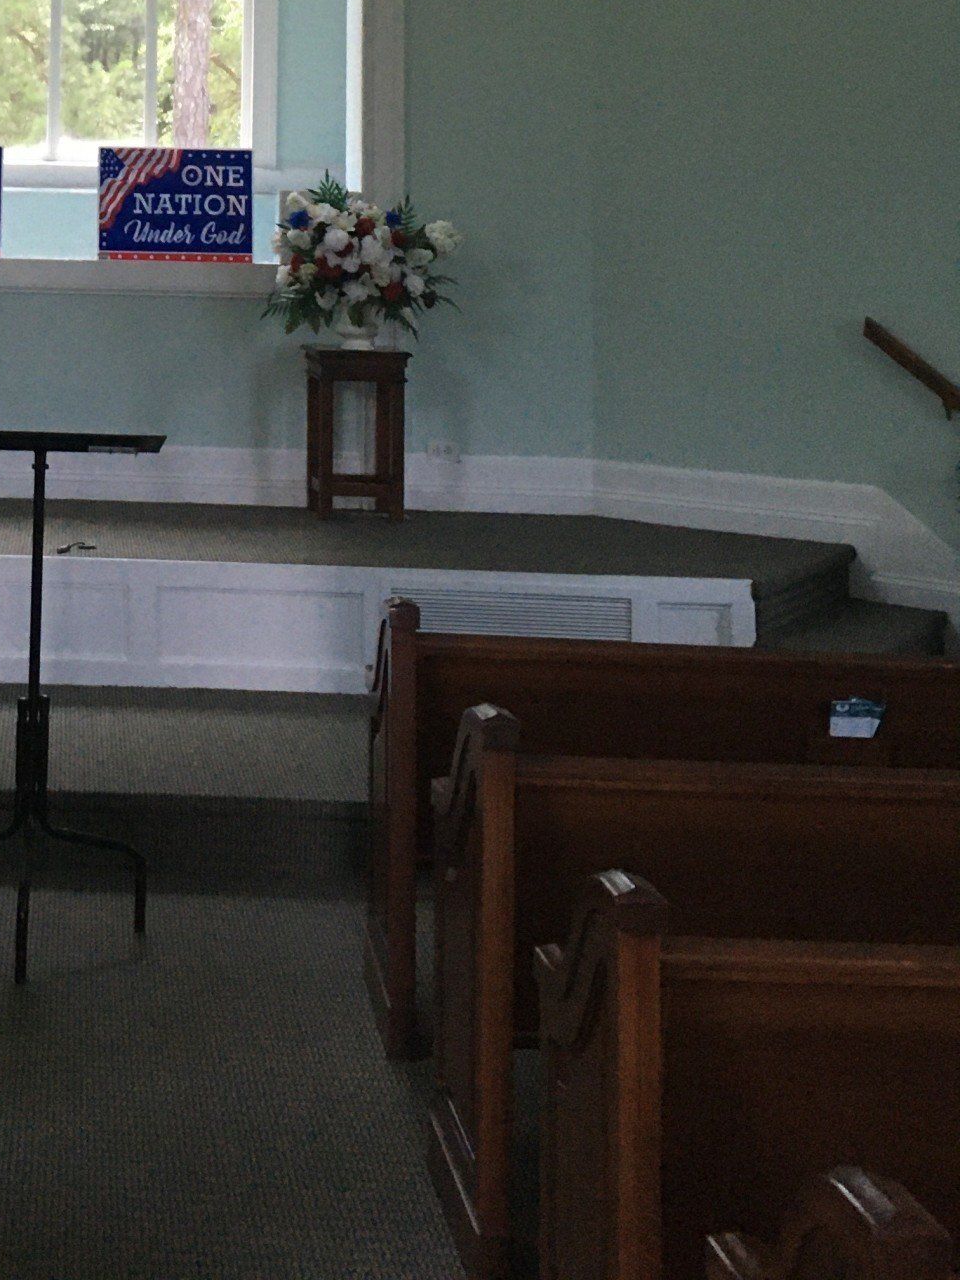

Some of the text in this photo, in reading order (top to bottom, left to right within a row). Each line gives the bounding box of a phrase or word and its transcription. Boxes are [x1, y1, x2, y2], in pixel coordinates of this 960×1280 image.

[181, 164, 244, 187] ONE
[133, 193, 248, 216] NATION
[124, 219, 246, 245] Under God
